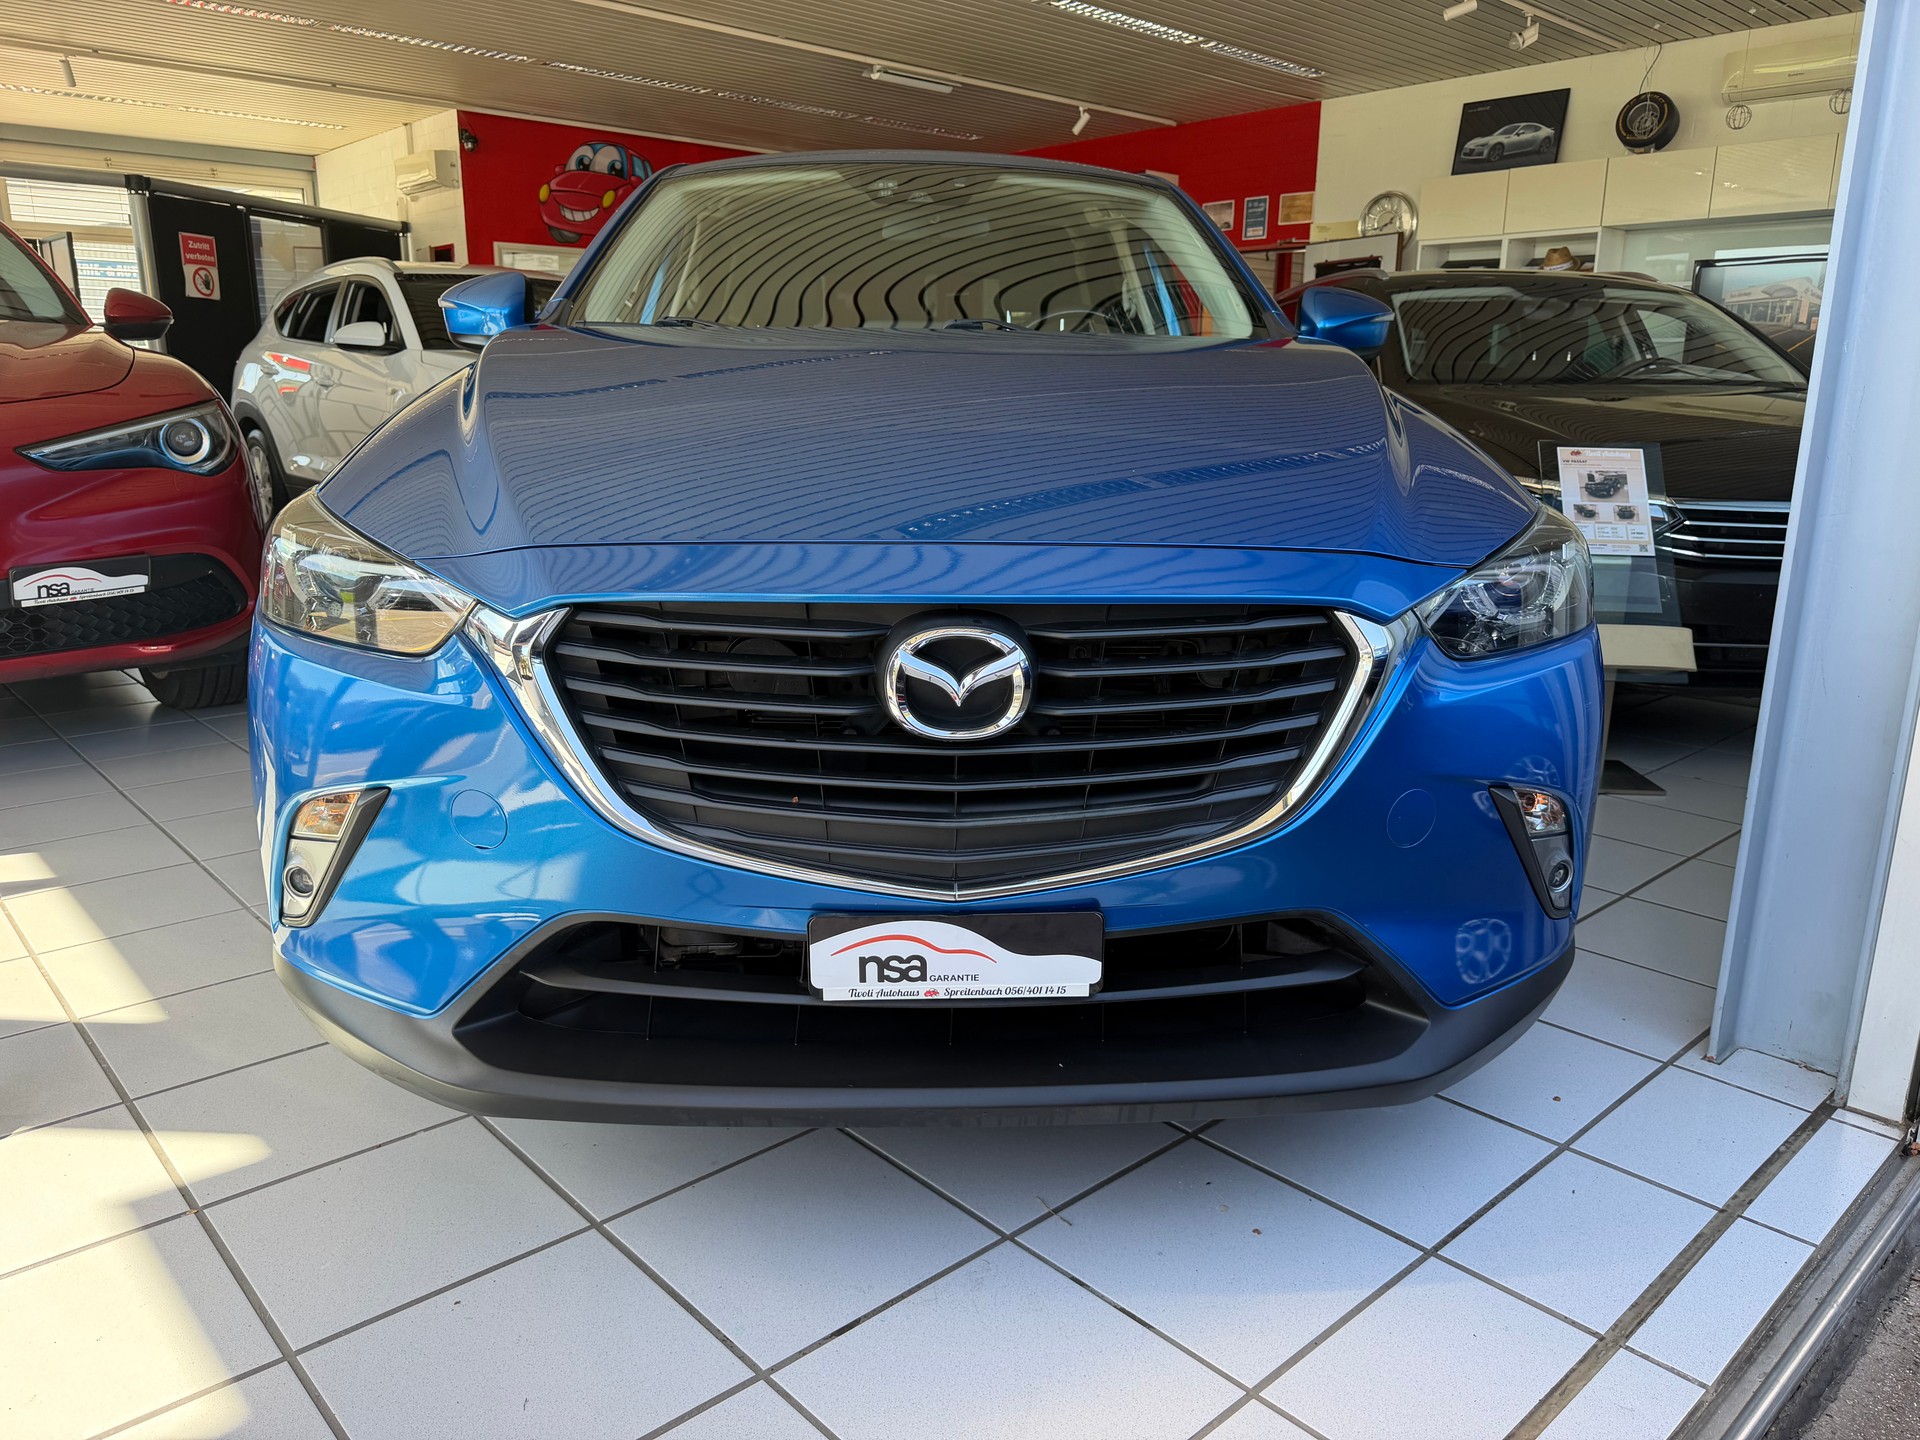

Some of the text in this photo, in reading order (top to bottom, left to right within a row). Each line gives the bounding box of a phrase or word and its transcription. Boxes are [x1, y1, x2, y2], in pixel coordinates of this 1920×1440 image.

[187, 240, 210, 251] Zutritt
[185, 252, 215, 263] verboten
[37, 582, 70, 599] nsa
[858, 954, 928, 984] nsa
[929, 973, 980, 983] GARANTIE
[848, 985, 1067, 999] Tivoli Autohaus Spreitenbach 056/401 14 15
